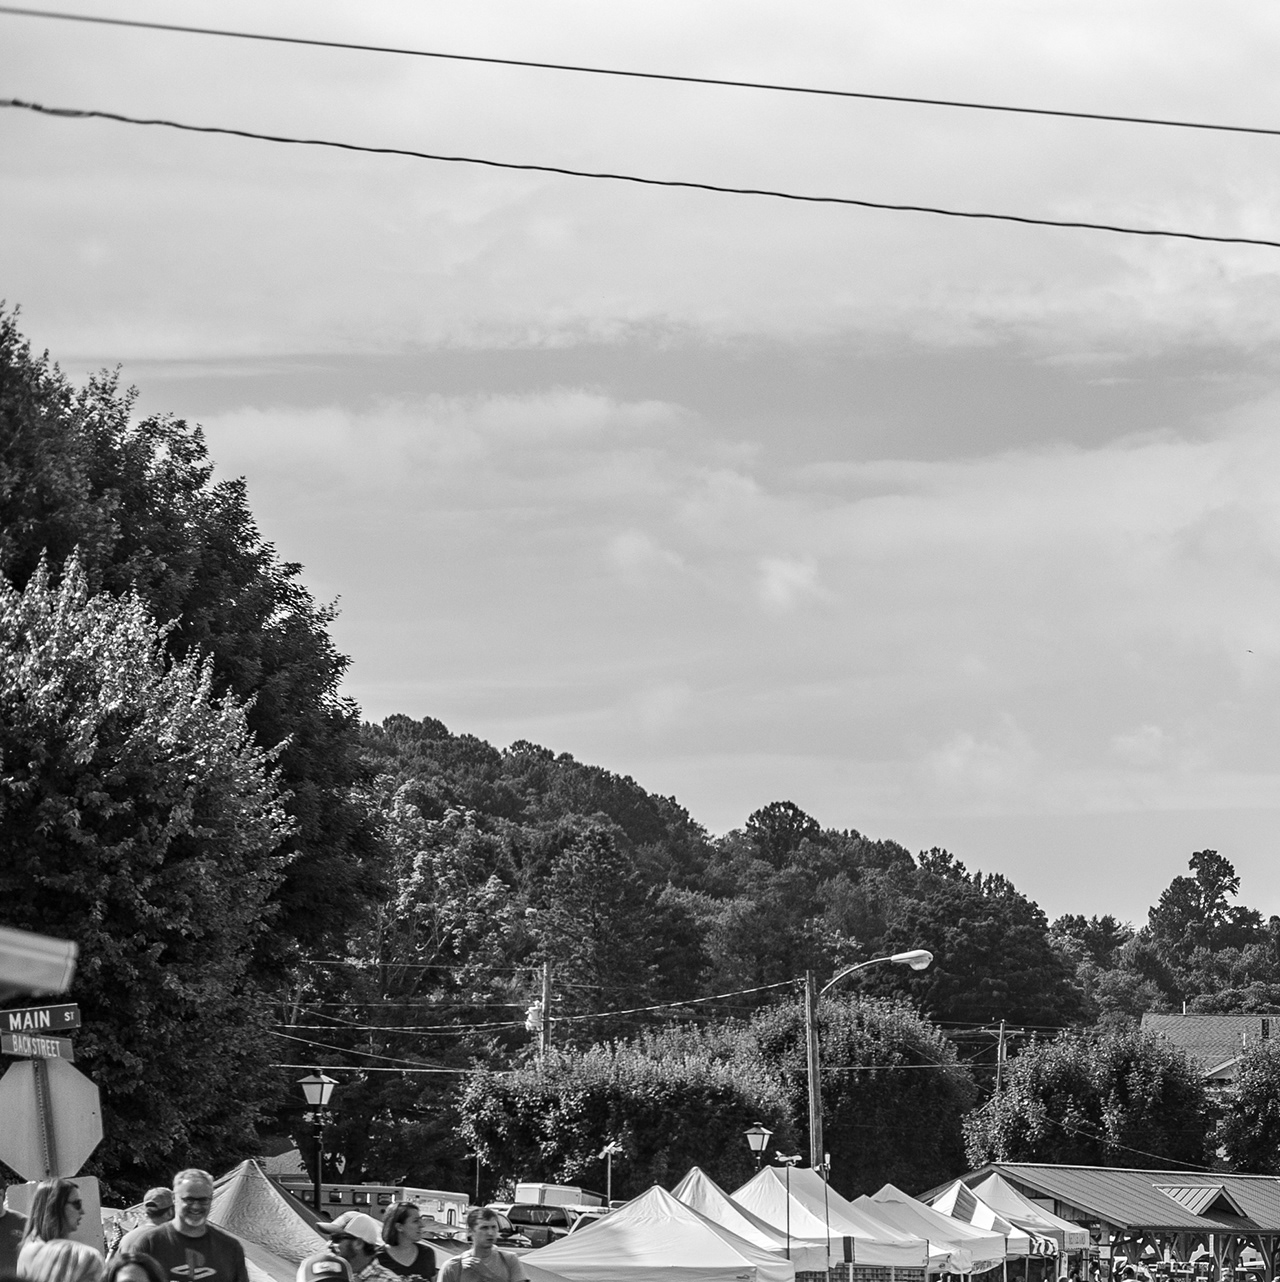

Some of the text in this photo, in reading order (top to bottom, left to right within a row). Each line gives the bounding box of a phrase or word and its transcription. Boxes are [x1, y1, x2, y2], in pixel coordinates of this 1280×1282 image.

[9, 1010, 75, 1031] MAIN ST
[12, 1034, 60, 1058] BACKSTREET
